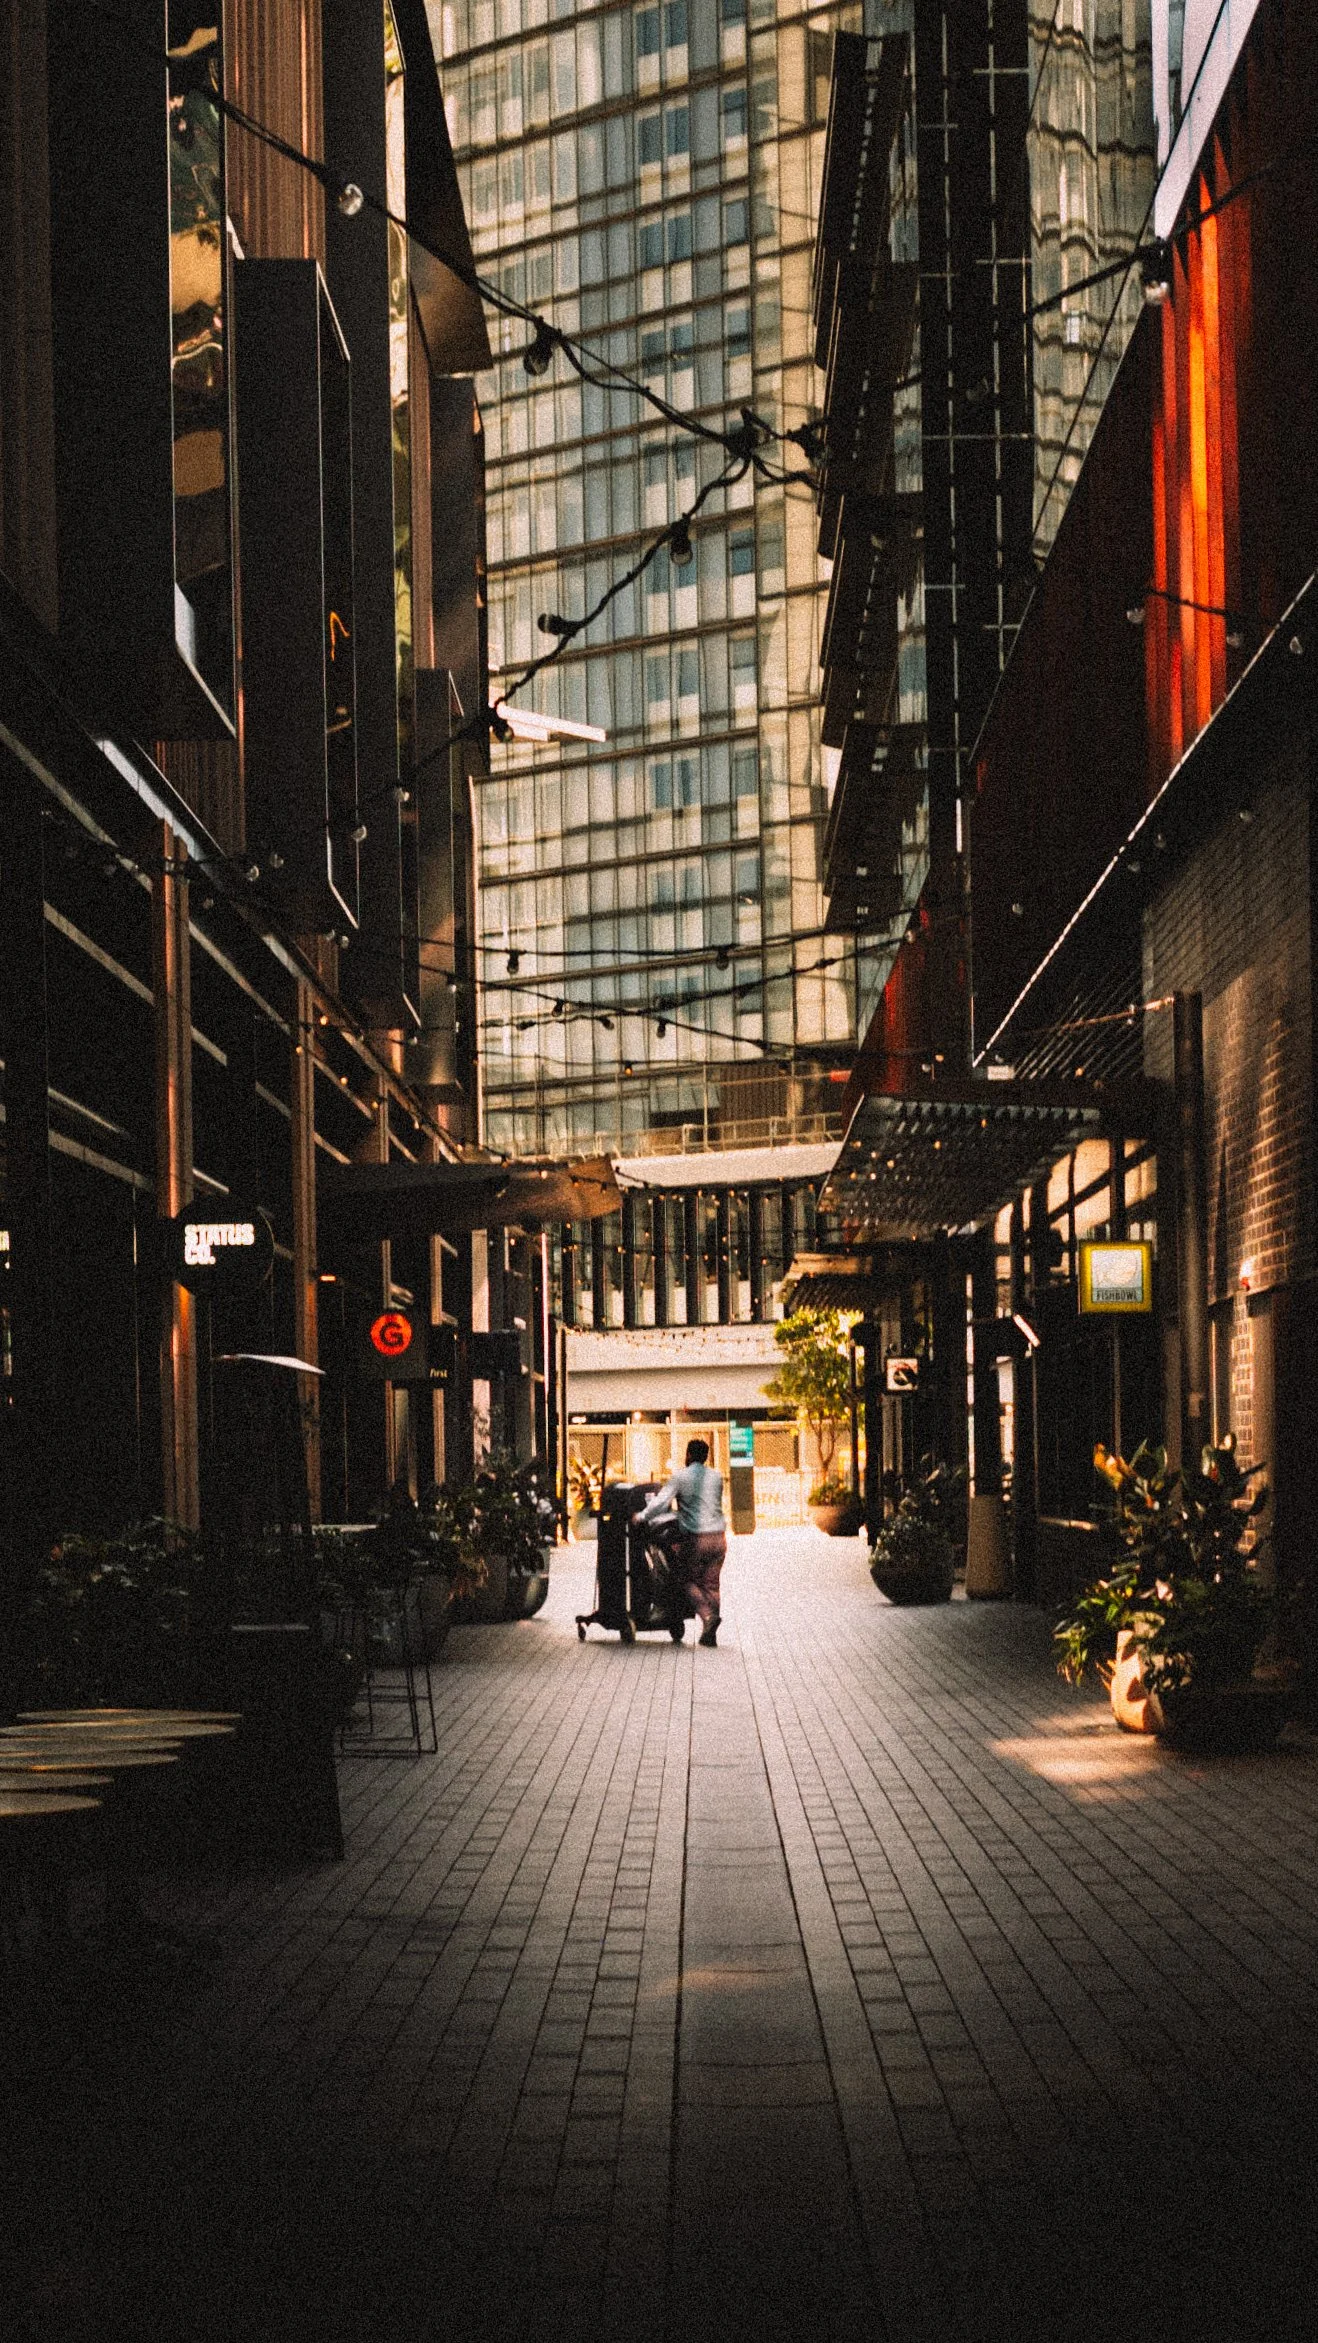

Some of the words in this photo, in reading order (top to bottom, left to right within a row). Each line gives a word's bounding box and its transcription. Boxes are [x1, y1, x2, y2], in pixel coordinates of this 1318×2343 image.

[184, 1223, 255, 1245] STATUS
[184, 1245, 217, 1265] CO.
[1096, 1288, 1138, 1301] FISHBOWL
[379, 1321, 404, 1347] G
